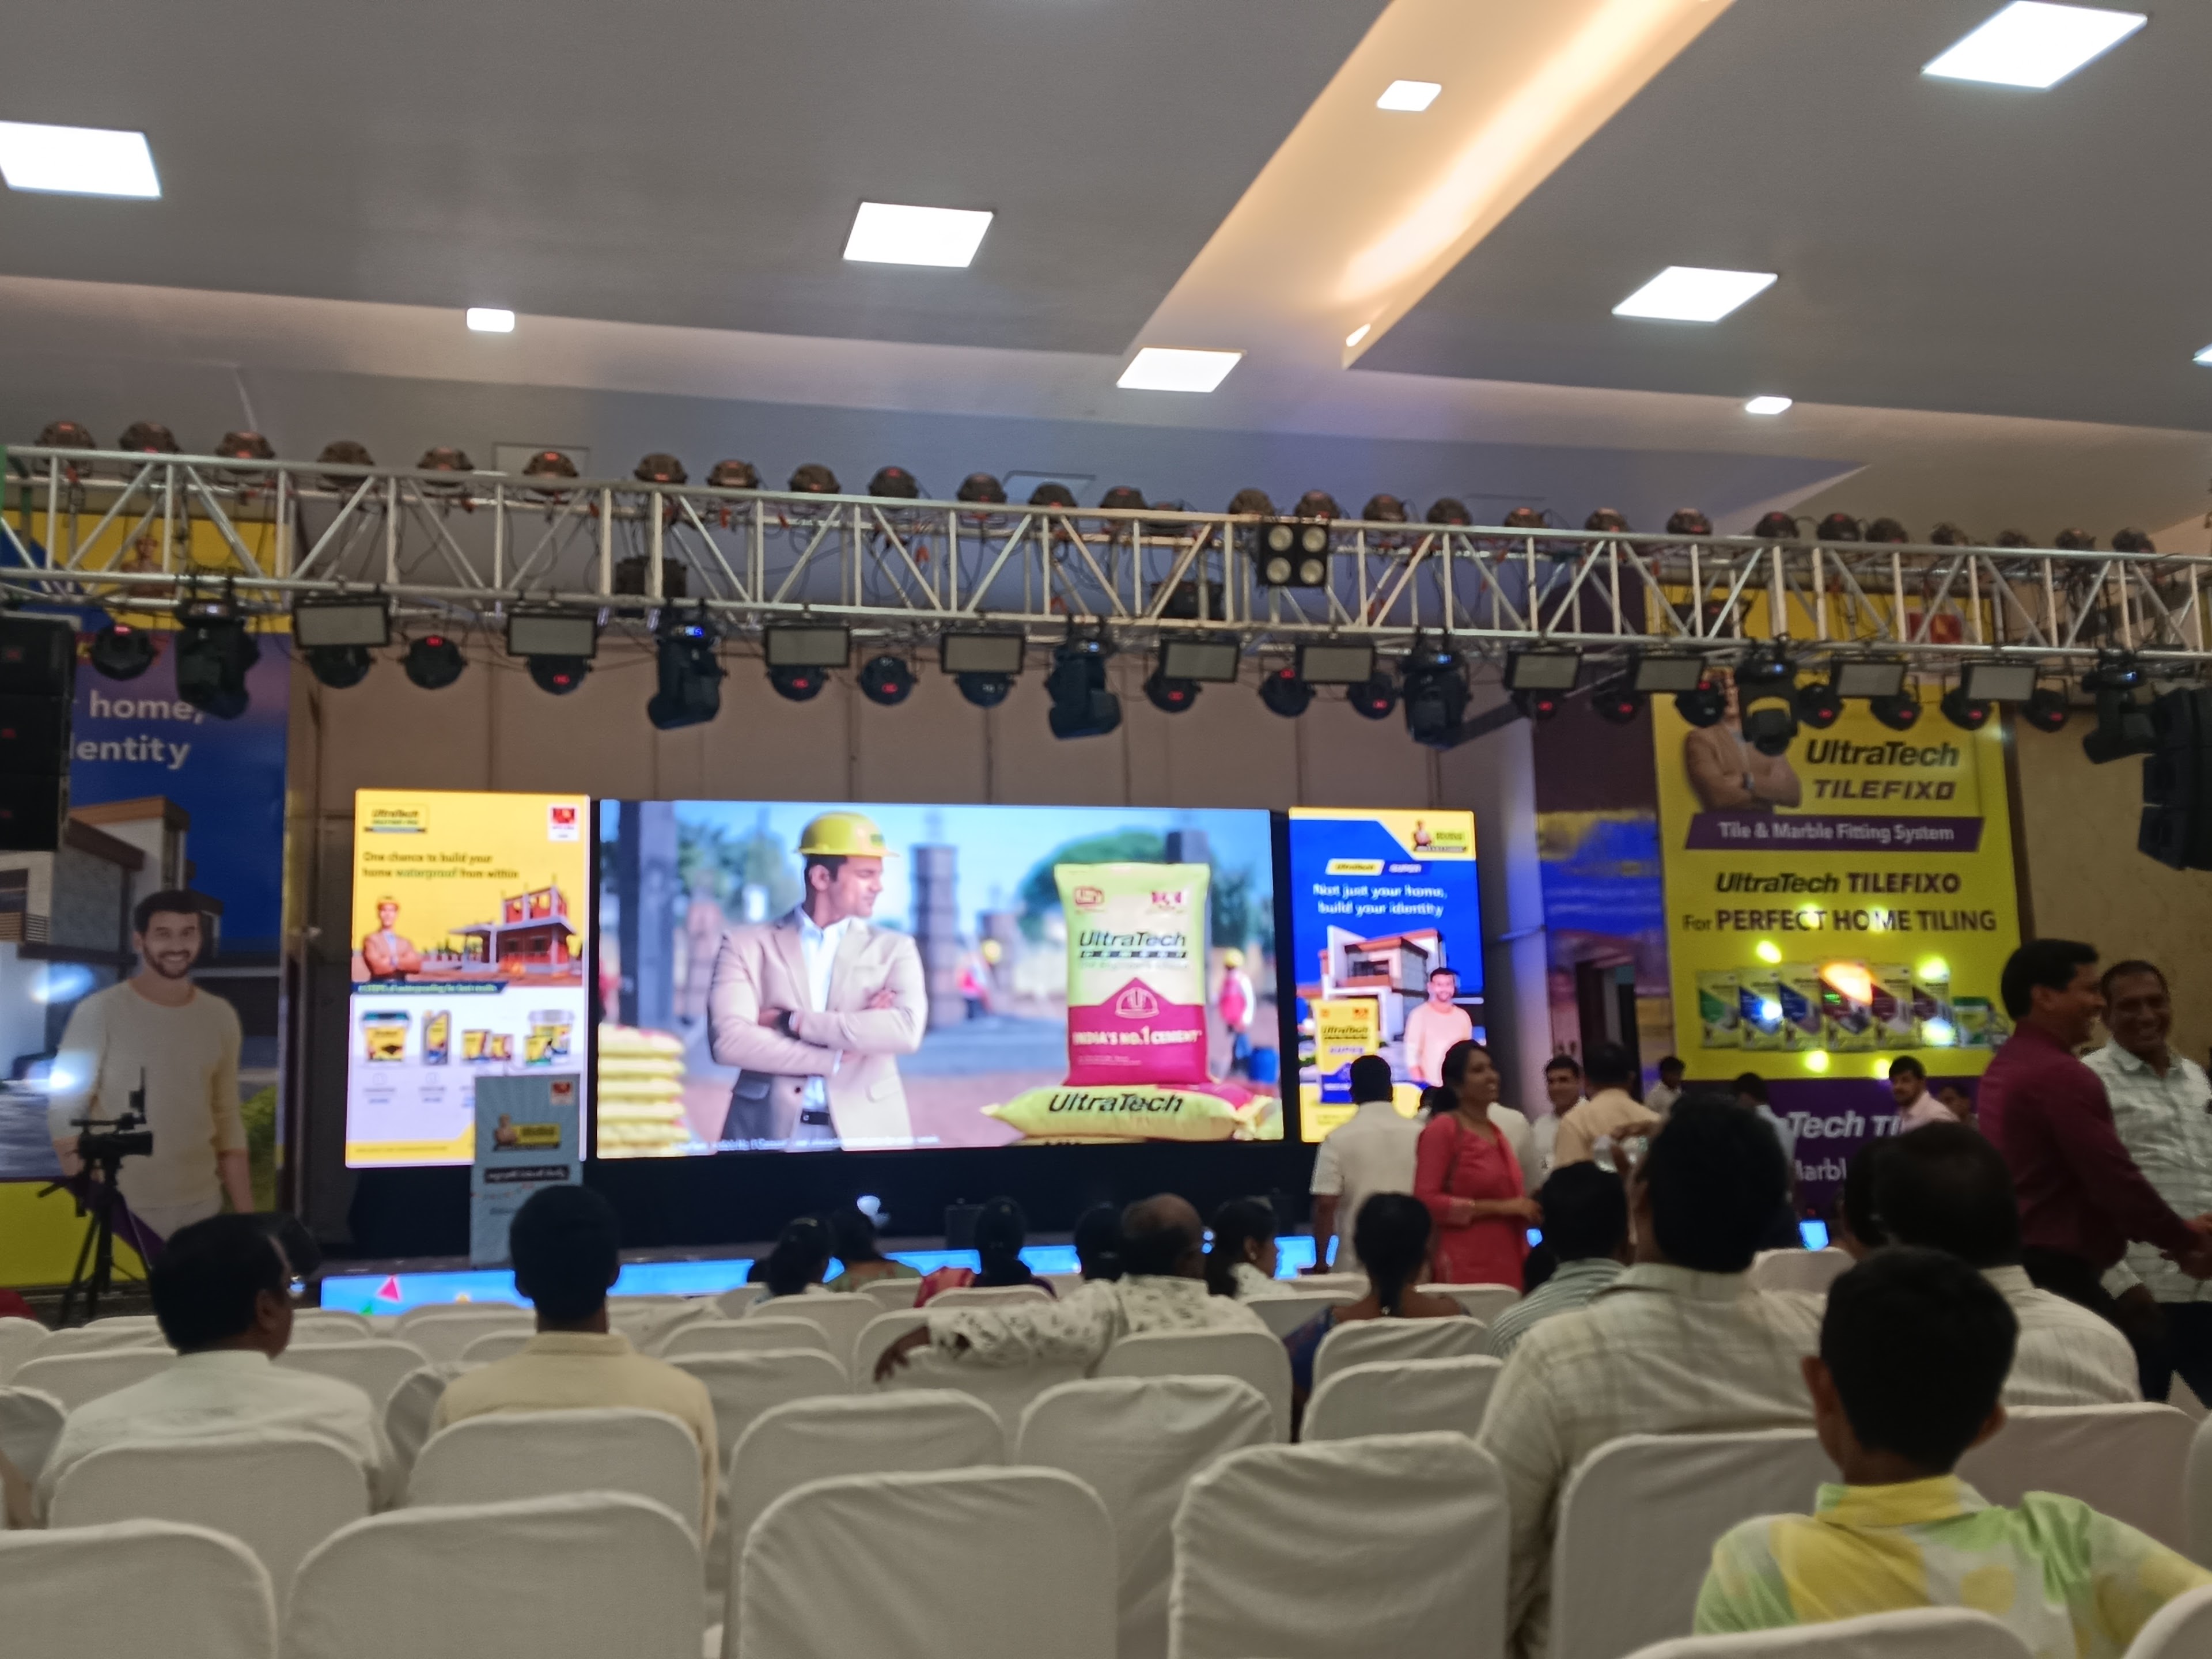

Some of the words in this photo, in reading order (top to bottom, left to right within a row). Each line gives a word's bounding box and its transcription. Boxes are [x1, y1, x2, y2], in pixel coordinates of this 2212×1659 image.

[69, 733, 191, 770] entity
[1806, 739, 1959, 767] UltraTech
[1815, 779, 1956, 800] TILEFIXO
[1718, 821, 1751, 839] Tile
[1753, 821, 1768, 839] &
[1772, 823, 1834, 840] Marble
[1836, 824, 1892, 844] Fitting
[1893, 825, 1955, 844] System
[1313, 883, 1340, 896] Not
[1342, 883, 1369, 899] just
[1370, 887, 1403, 900] your
[1716, 873, 1840, 892] UltraTech
[1847, 873, 1961, 892] TILEFIXO
[1318, 900, 1353, 914] build
[1355, 904, 1387, 918] your
[1389, 901, 1444, 918] identity
[1683, 915, 1711, 930] For
[1715, 910, 1827, 931] PERFECT
[1834, 910, 1911, 931] HOME
[1916, 911, 1997, 931] TILING
[1080, 931, 1186, 946] UltraTech
[1048, 1093, 1184, 1112] UltraTech
[1787, 1110, 1866, 1138] Tech
[1795, 1157, 1847, 1181] arbl
